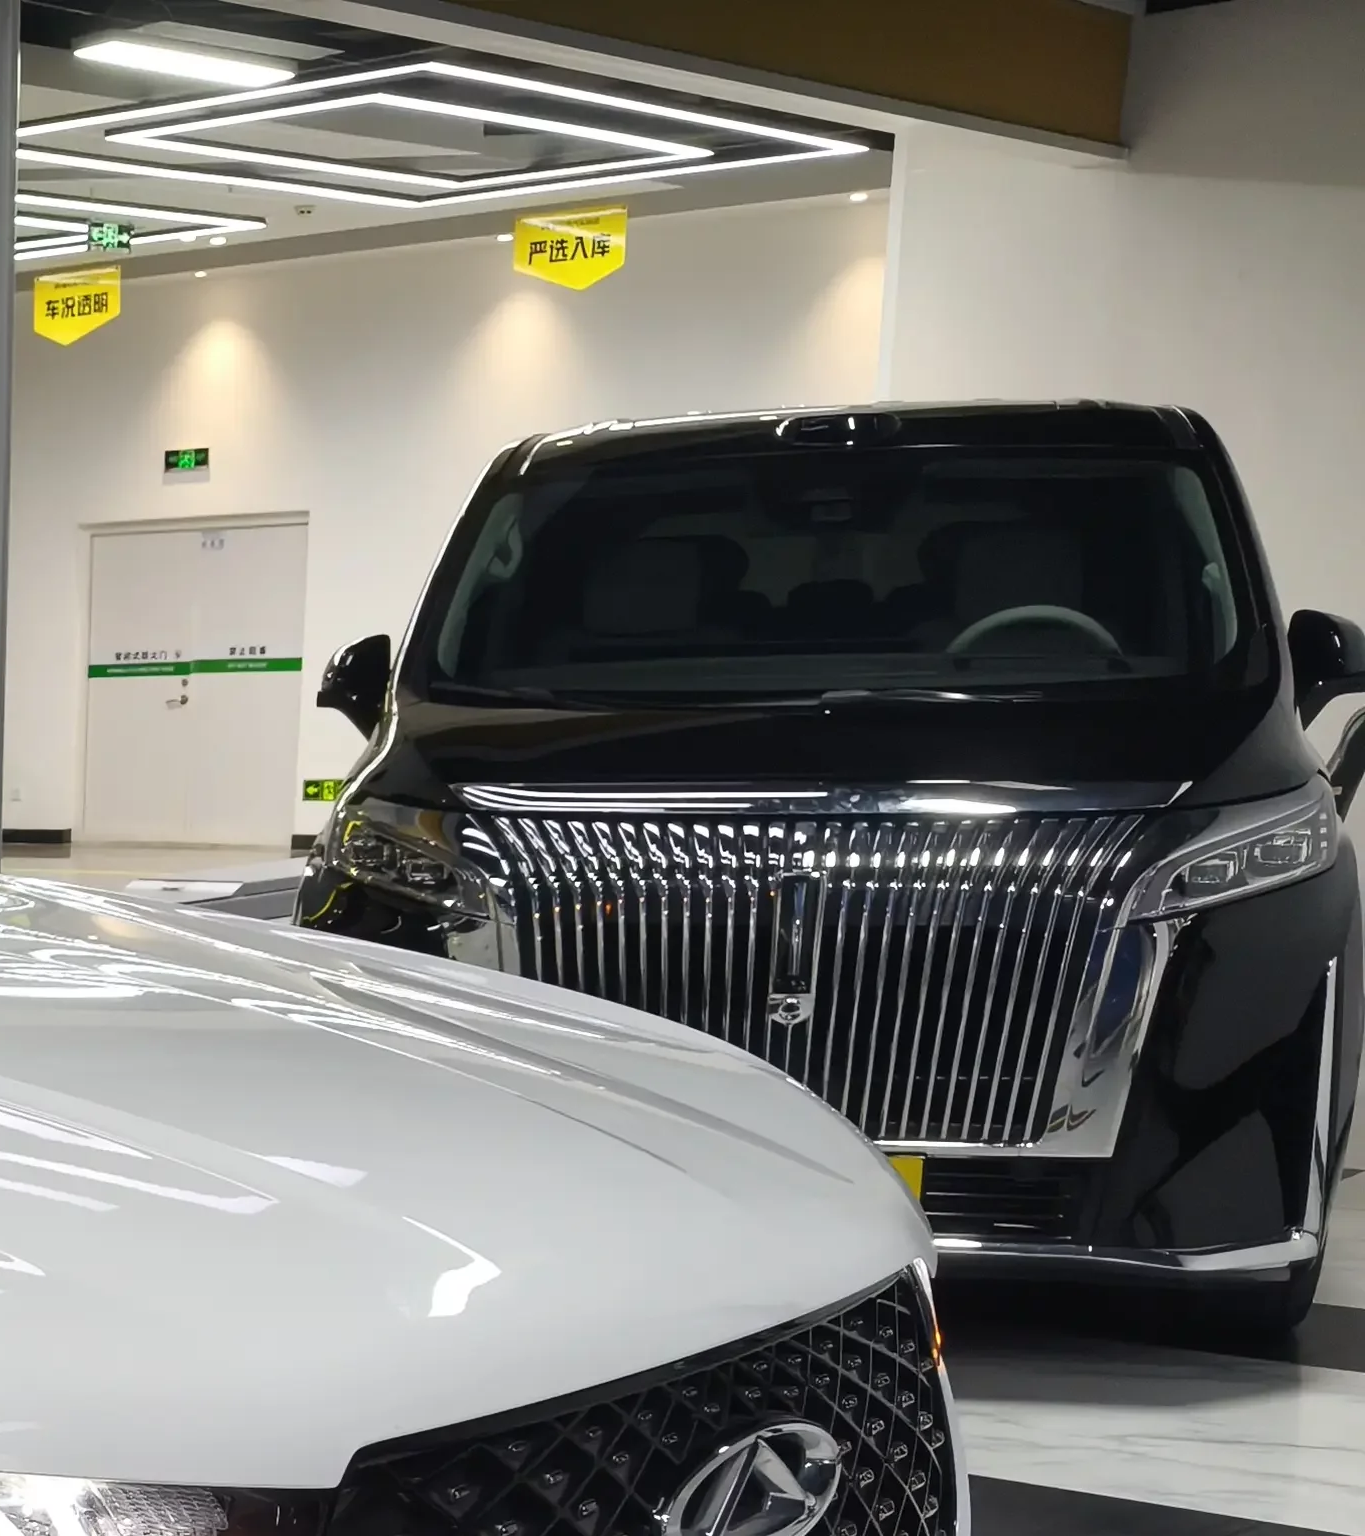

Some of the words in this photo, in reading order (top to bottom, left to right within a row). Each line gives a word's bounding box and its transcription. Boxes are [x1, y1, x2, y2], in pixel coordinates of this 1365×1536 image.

[528, 233, 611, 265] 严选入库
[45, 292, 109, 320] 车况透明
